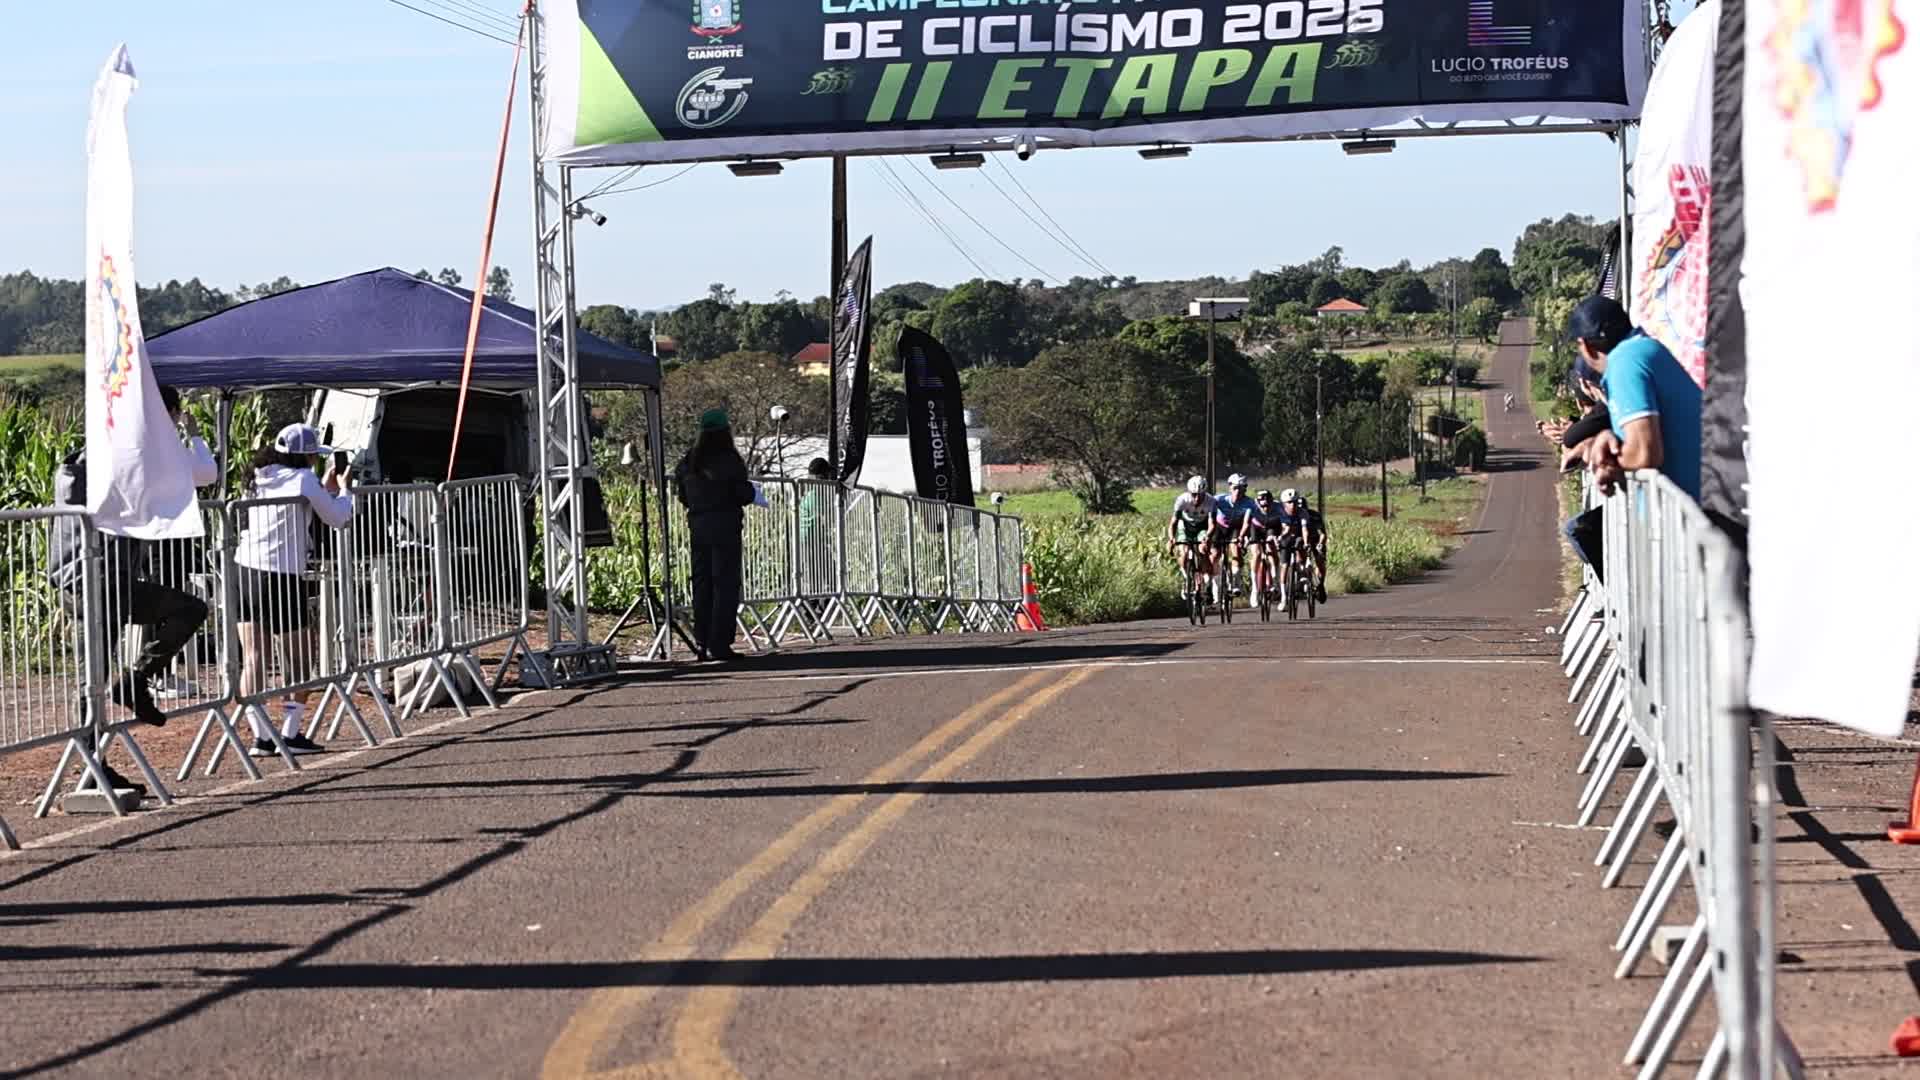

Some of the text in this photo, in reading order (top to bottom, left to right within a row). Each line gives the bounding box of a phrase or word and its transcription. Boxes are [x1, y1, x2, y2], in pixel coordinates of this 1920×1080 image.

[687, 49, 744, 60] CIANORTE
[823, 20, 903, 61] DE
[922, 3, 1204, 56] CICLÍSMO
[866, 42, 1322, 122] II ETAPA
[1431, 54, 1570, 73] LUCIO TROFÉUS
[927, 400, 945, 469] TROFÉUS
